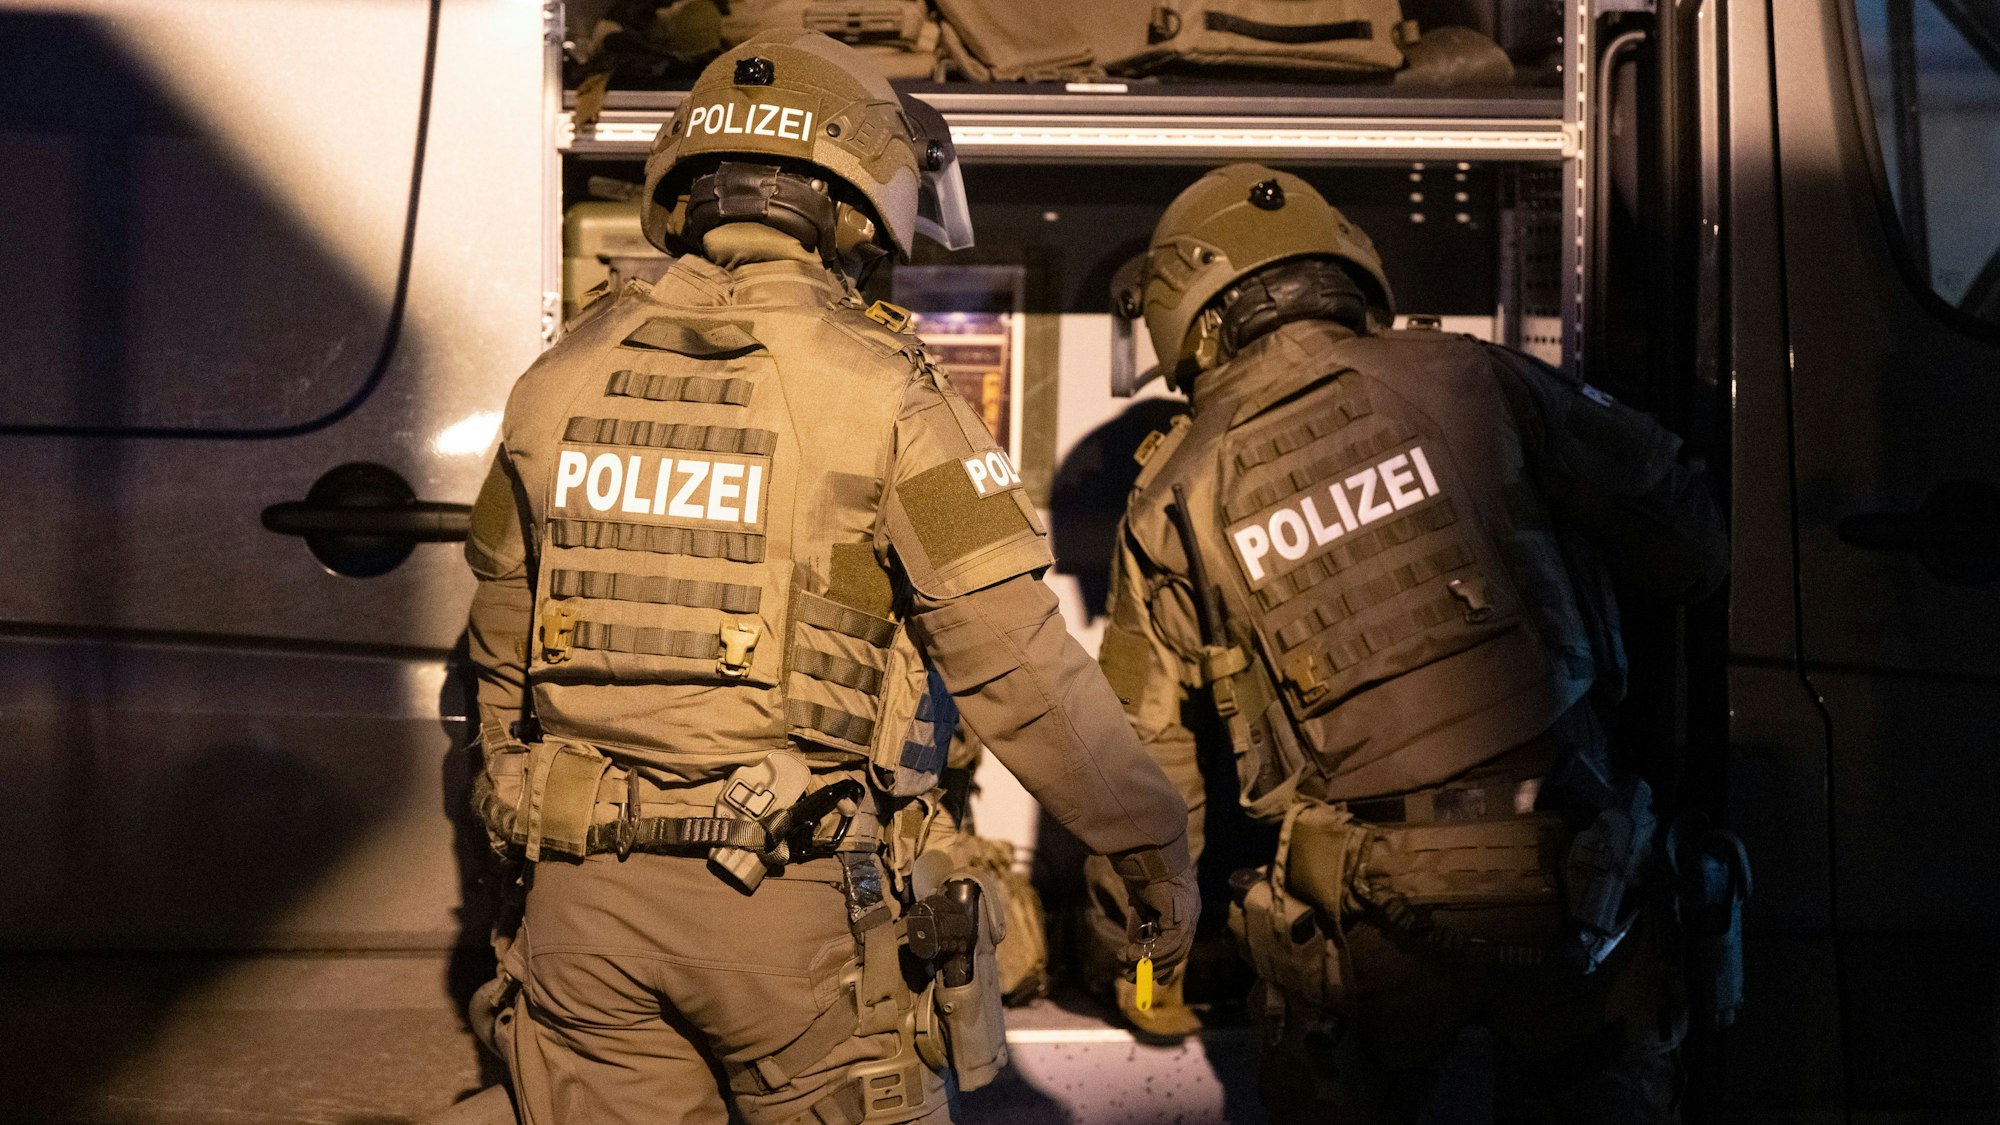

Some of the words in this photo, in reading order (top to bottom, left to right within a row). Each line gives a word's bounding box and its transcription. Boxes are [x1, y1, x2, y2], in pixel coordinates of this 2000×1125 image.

[686, 103, 813, 142] POLIZEI
[554, 450, 763, 524] POLIZEI
[1233, 446, 1440, 581] POLIZEI
